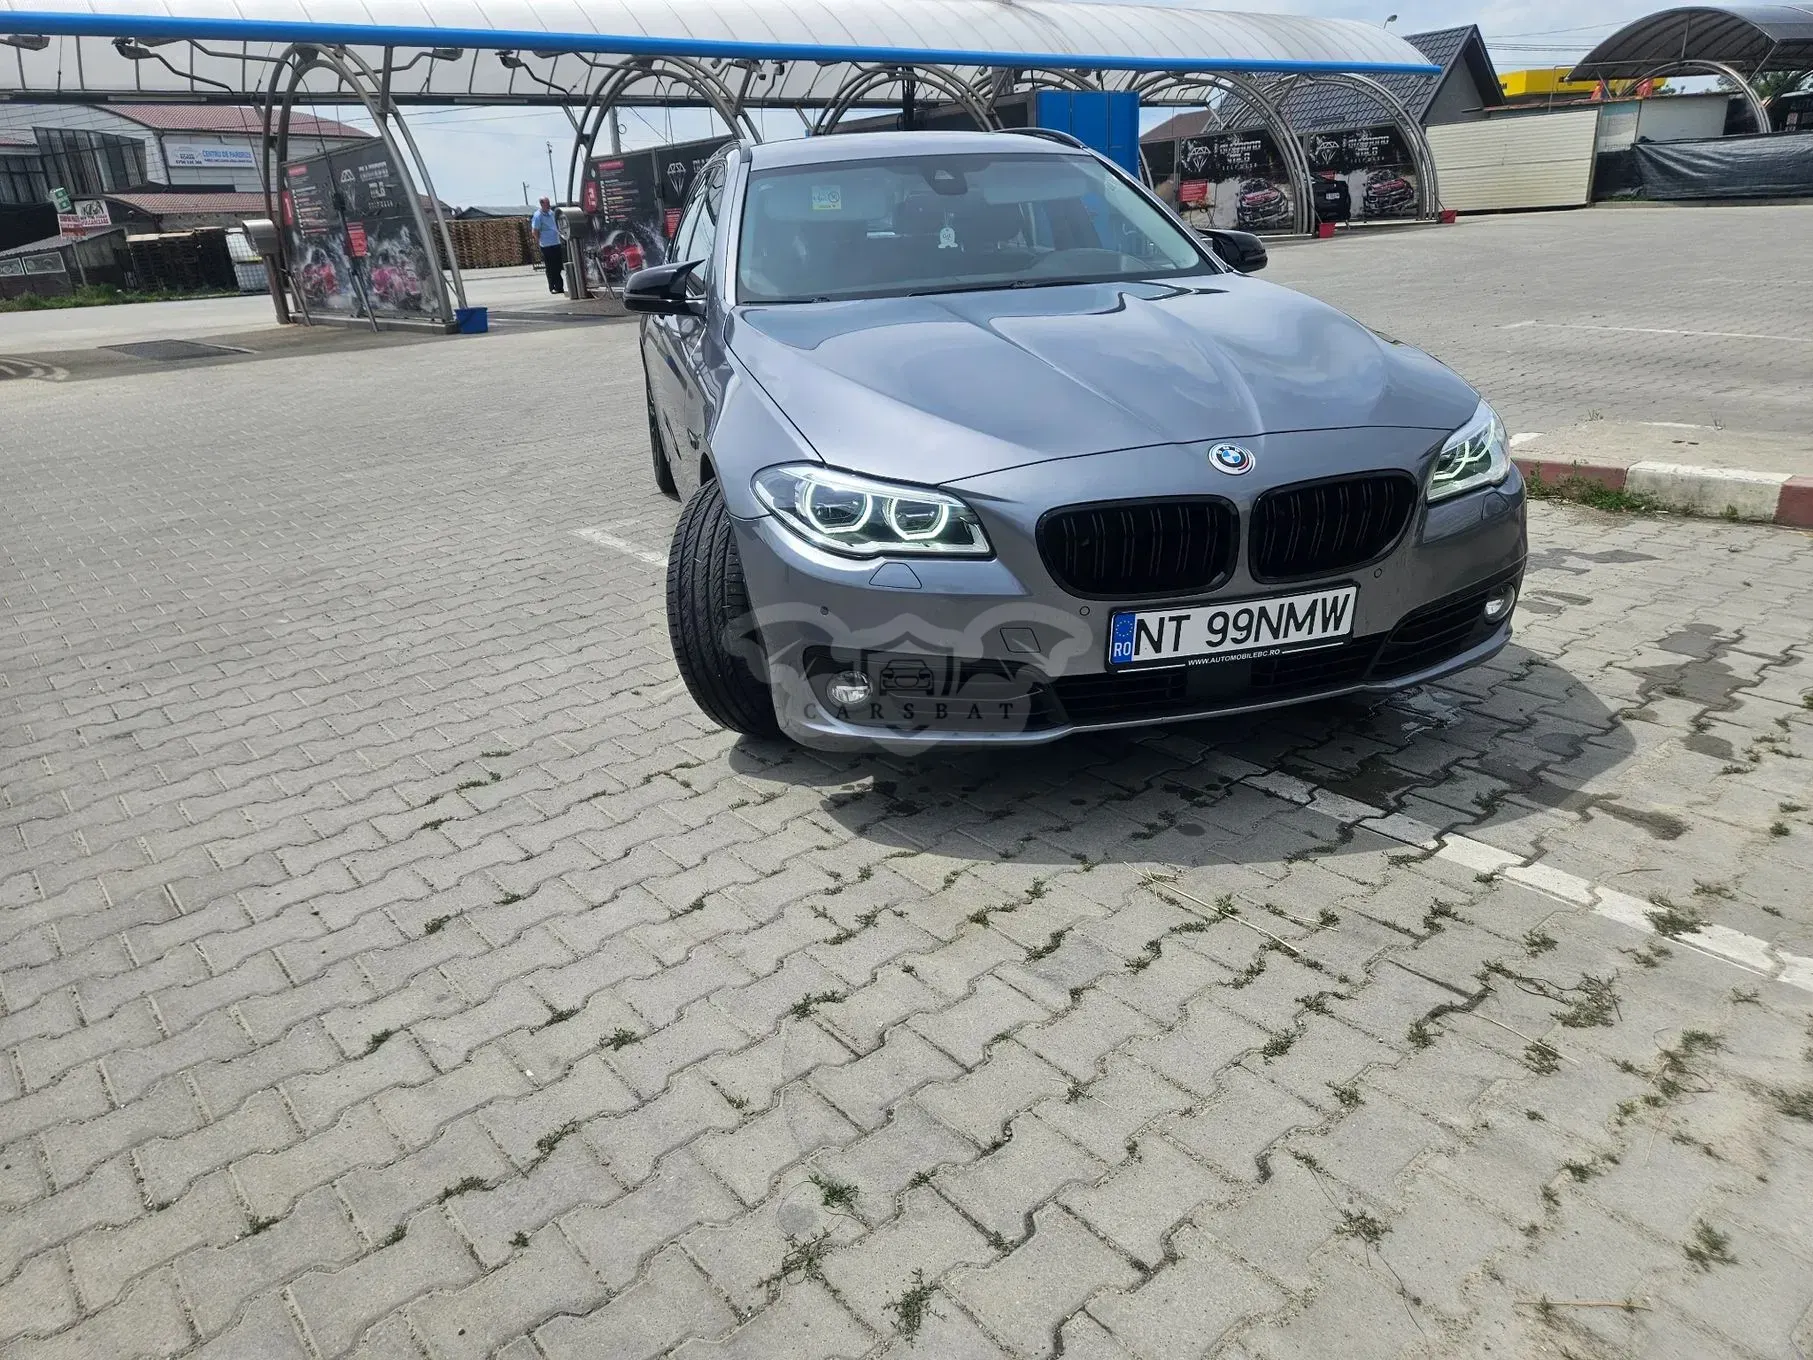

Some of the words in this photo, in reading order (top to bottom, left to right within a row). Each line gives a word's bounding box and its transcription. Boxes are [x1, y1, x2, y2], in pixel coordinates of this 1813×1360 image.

[1134, 614, 1191, 656] NT
[1205, 593, 1351, 648] 99NMW
[1113, 641, 1131, 657] RO
[1188, 648, 1281, 666] WWW.AUTOMOBILEBC.RO
